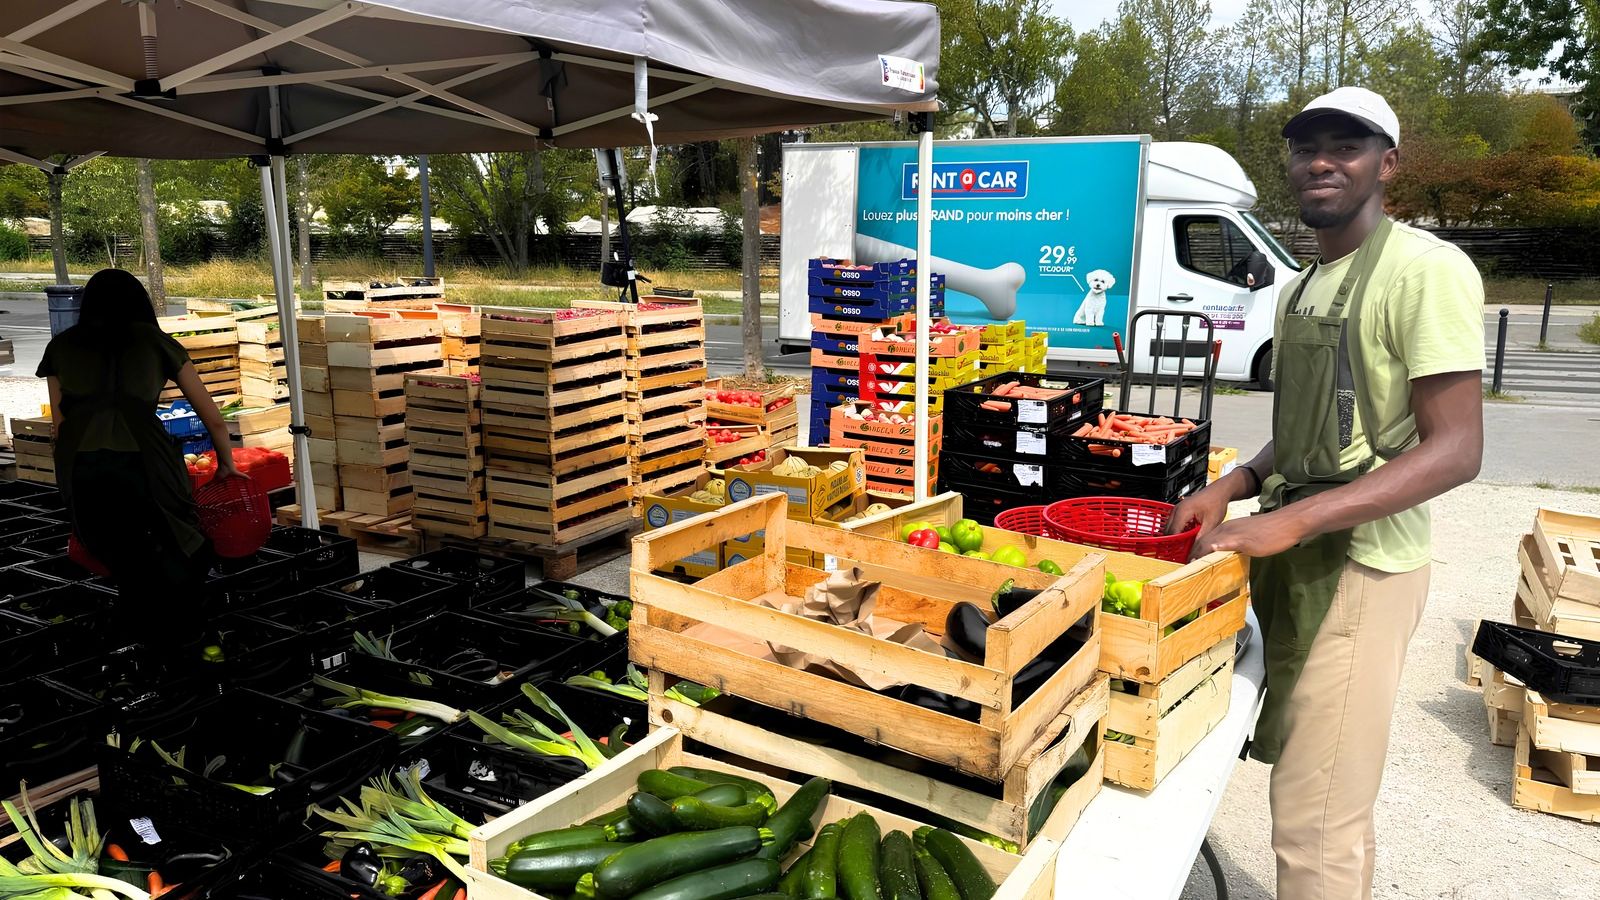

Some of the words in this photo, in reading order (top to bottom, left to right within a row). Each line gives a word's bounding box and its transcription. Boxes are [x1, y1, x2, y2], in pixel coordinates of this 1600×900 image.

[912, 172, 957, 189] RNT
[961, 172, 973, 185] a
[978, 171, 1017, 188] CAR
[863, 209, 893, 221] Louez
[896, 209, 918, 224] plus
[931, 210, 964, 221] RAND
[967, 211, 993, 224] pour
[996, 208, 1032, 221] moins
[1035, 208, 1063, 221] cher
[841, 271, 860, 279] OSSO
[842, 289, 860, 297] OSSO
[842, 307, 861, 315] OSSO
